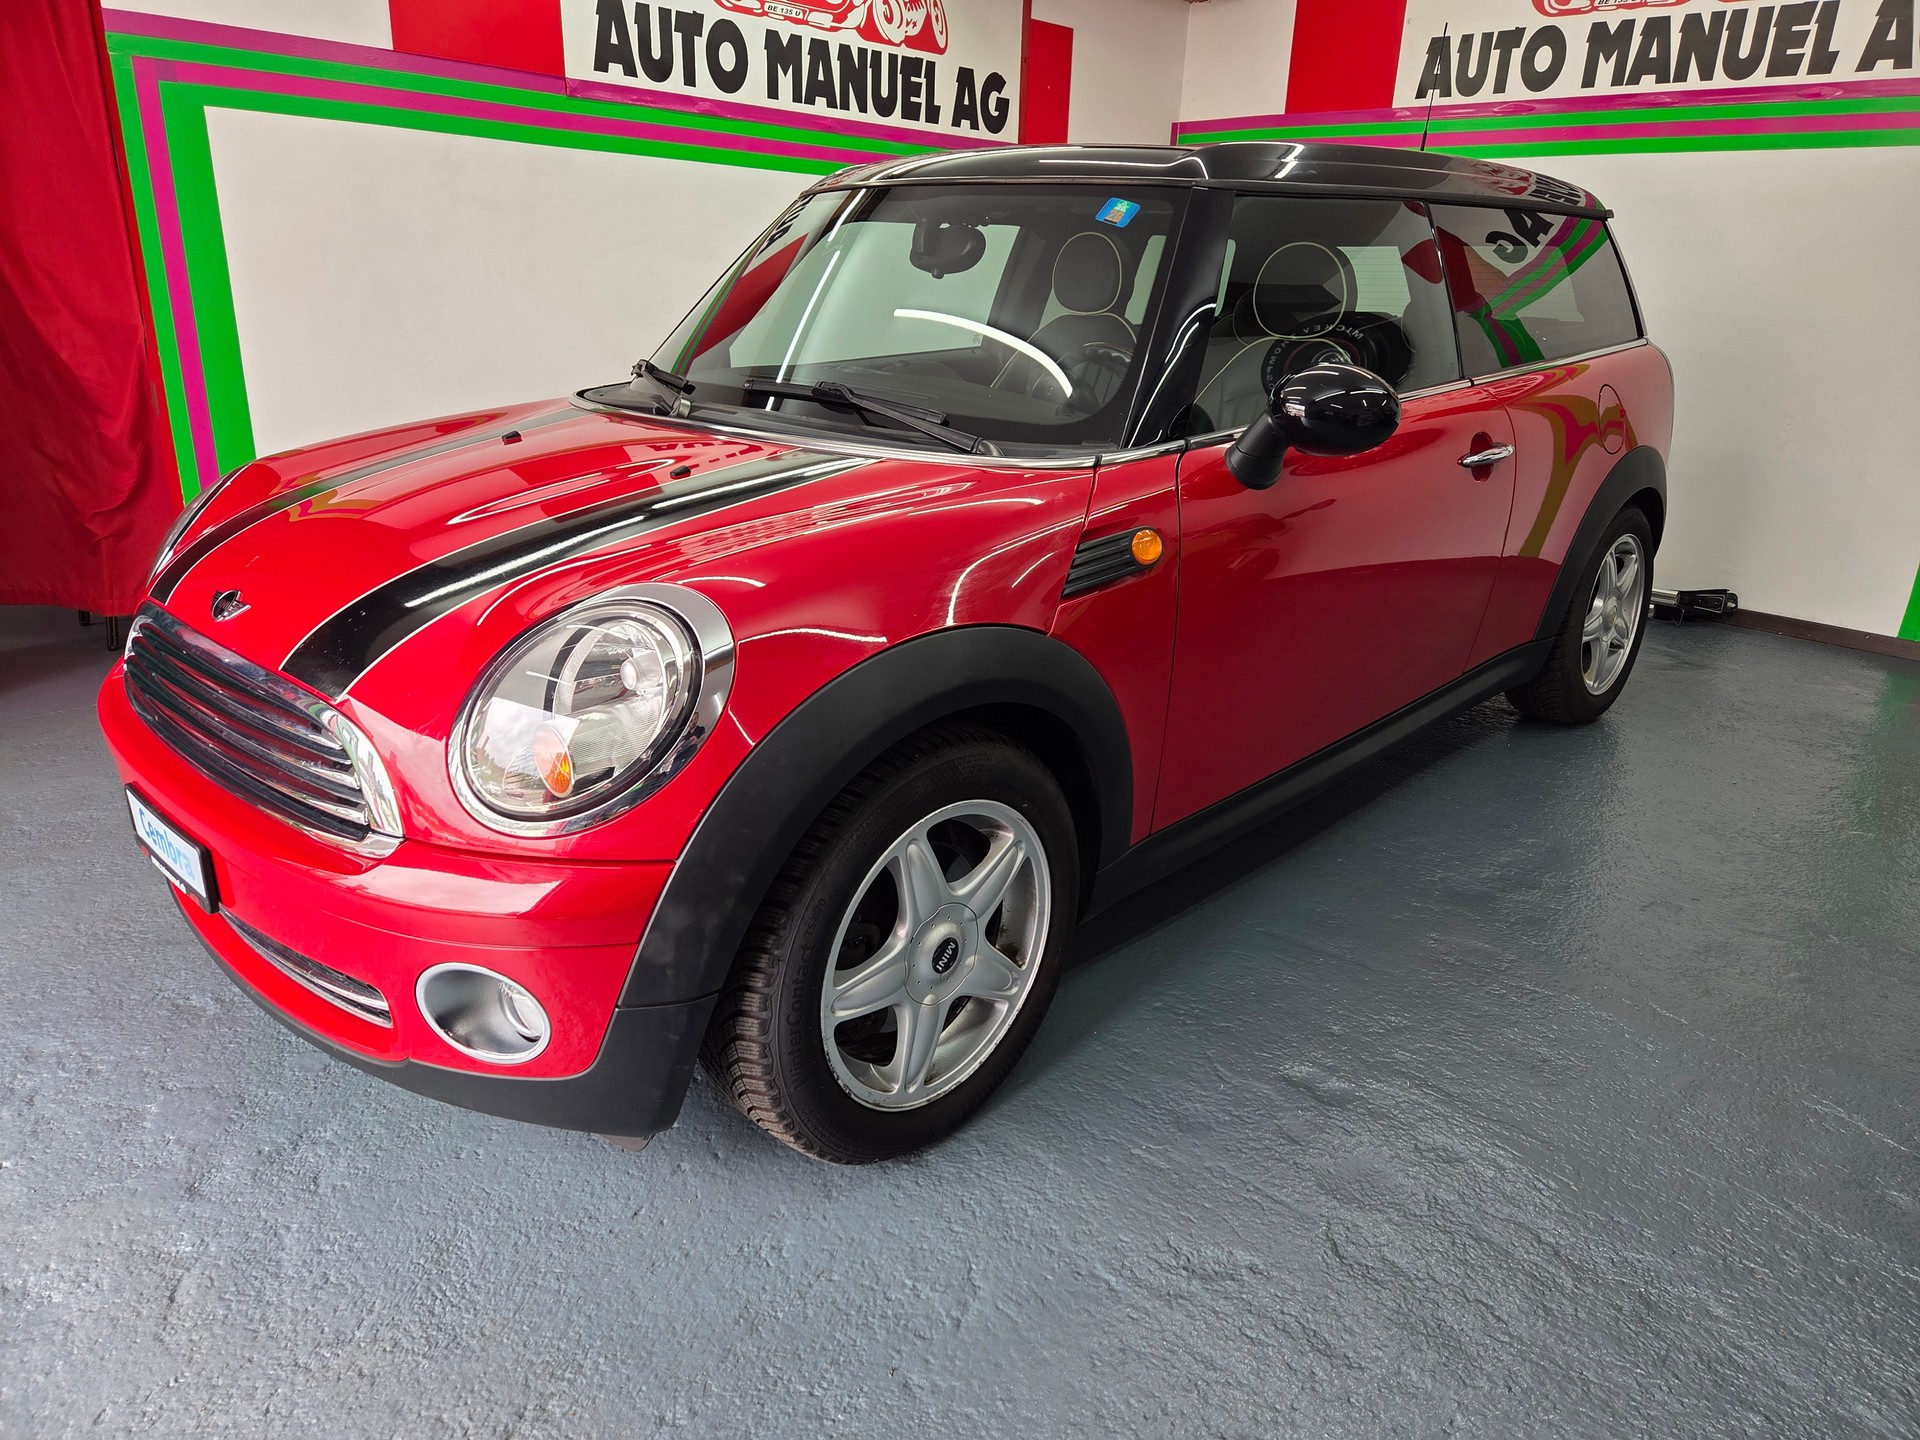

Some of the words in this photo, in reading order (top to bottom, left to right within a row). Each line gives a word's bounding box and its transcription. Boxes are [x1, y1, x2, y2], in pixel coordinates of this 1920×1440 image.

[767, 4, 778, 13] BE
[780, 7, 794, 16] 135
[593, 0, 749, 94] AUTO
[764, 29, 941, 125] MANUEL
[951, 66, 1010, 135] AG
[1414, 24, 1567, 99] AUTO
[1581, 0, 1841, 89] MANUEL
[1854, 0, 1920, 72] A
[138, 807, 196, 881] Cembra
[935, 941, 956, 971] MINI
